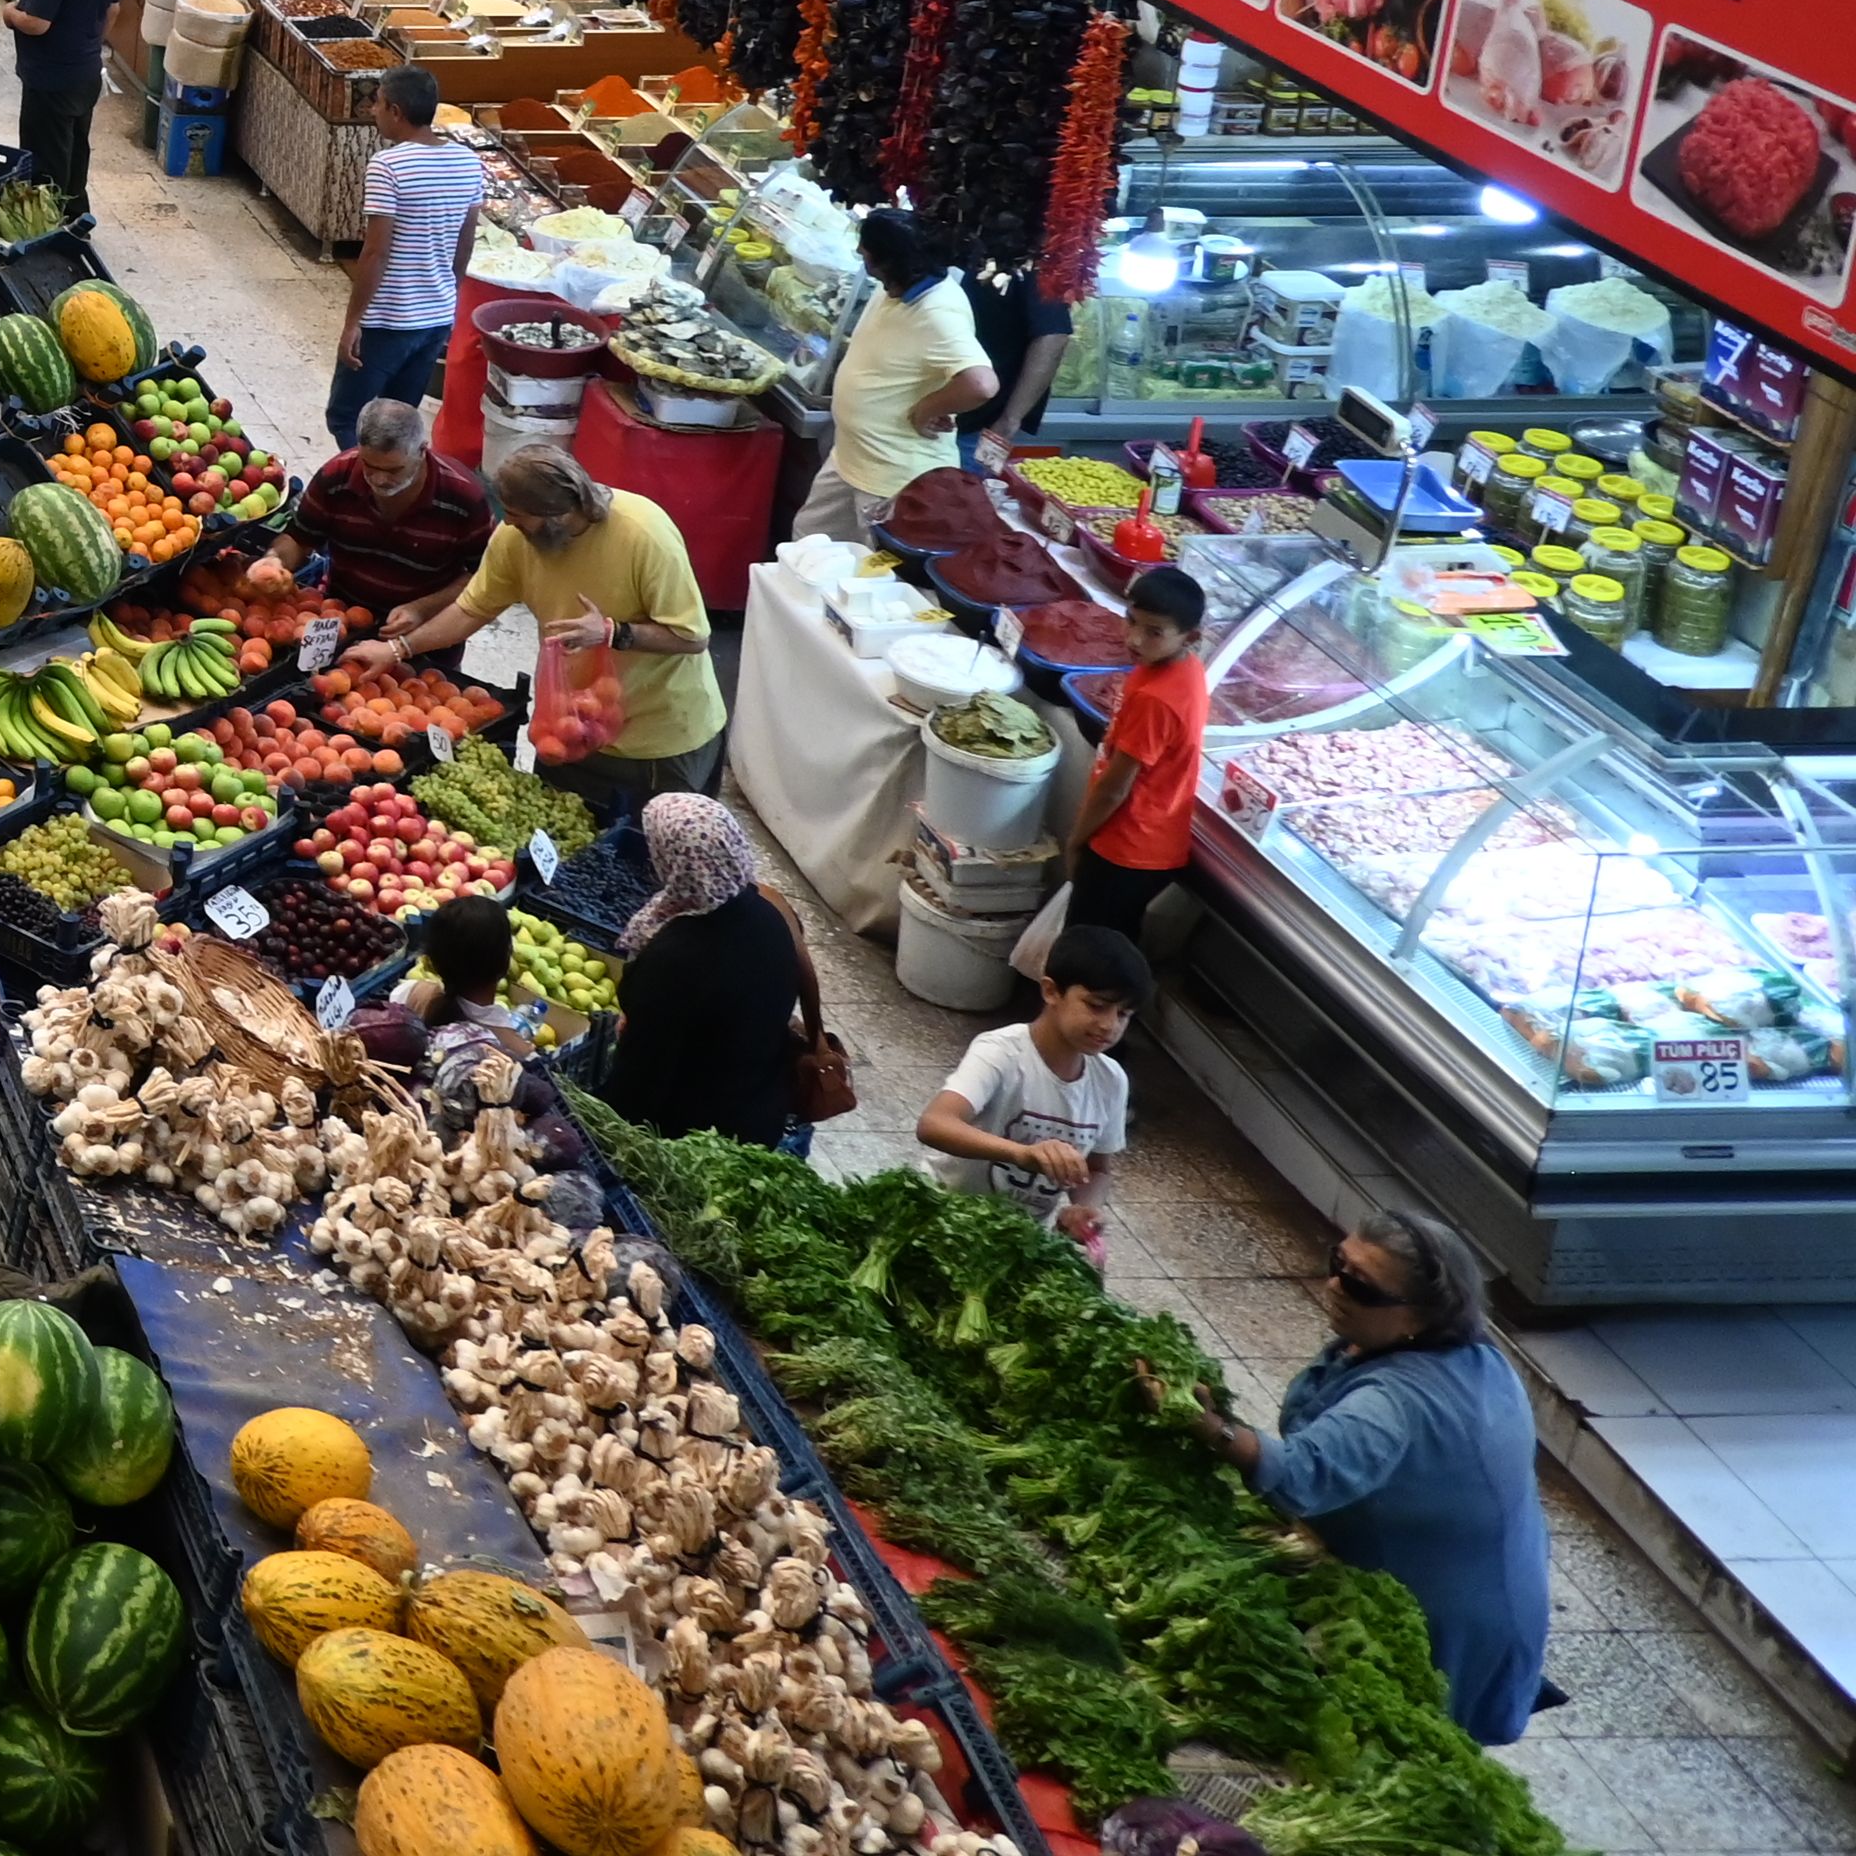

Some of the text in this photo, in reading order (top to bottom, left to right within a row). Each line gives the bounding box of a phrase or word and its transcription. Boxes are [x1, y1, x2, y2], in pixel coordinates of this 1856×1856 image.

[224, 904, 263, 935] 35
[1658, 1042, 1738, 1058] TÜM PİLİÇ
[1699, 1062, 1739, 1093] 85
